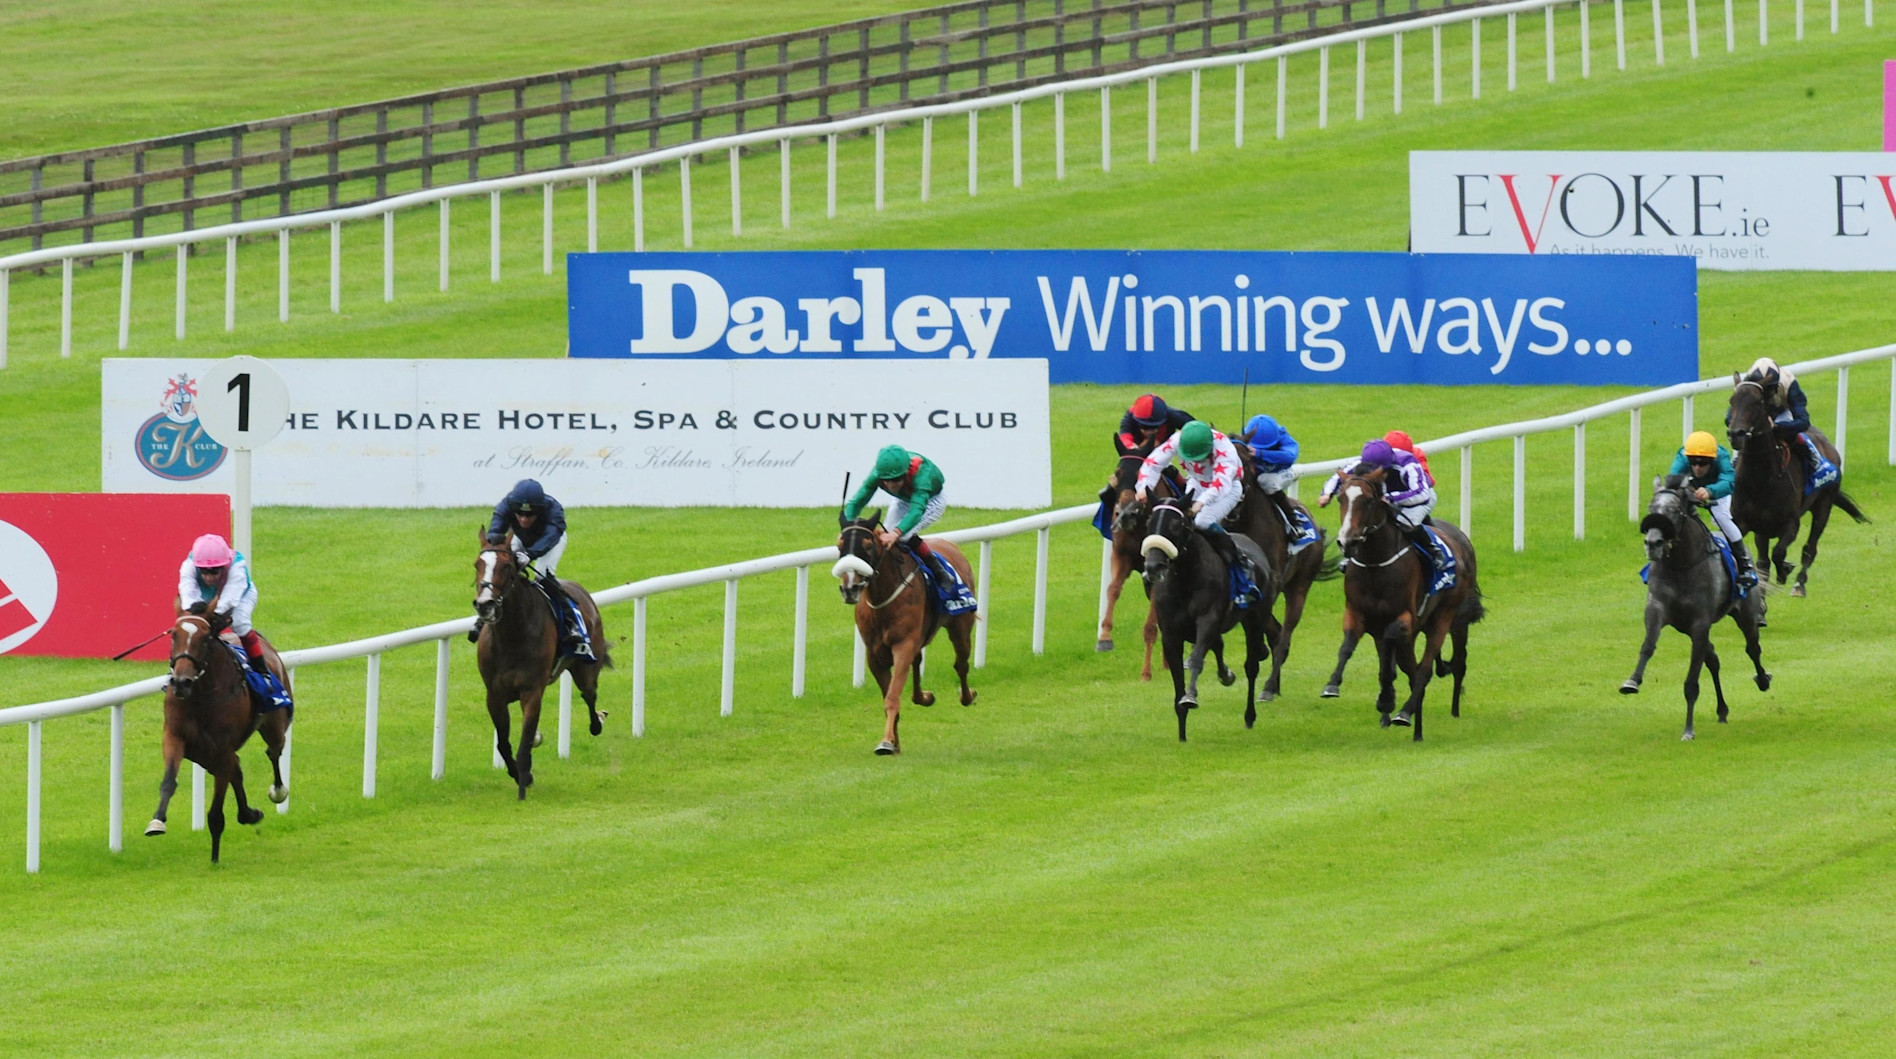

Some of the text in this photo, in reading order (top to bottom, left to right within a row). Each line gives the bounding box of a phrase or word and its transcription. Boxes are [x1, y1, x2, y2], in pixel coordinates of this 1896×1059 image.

[1453, 172, 1770, 254] EVOKE.ie
[1709, 243, 1749, 259] have
[628, 267, 1633, 375] Darley Winning ways...
[227, 373, 251, 432] 1
[336, 409, 481, 431] KILDARE
[633, 409, 699, 430] SPA
[714, 409, 737, 430] &
[753, 409, 912, 430] COUNTRY
[927, 409, 1018, 430] CLUB
[150, 421, 206, 469] K
[472, 453, 497, 469] at
[721, 446, 805, 470] Ireland
